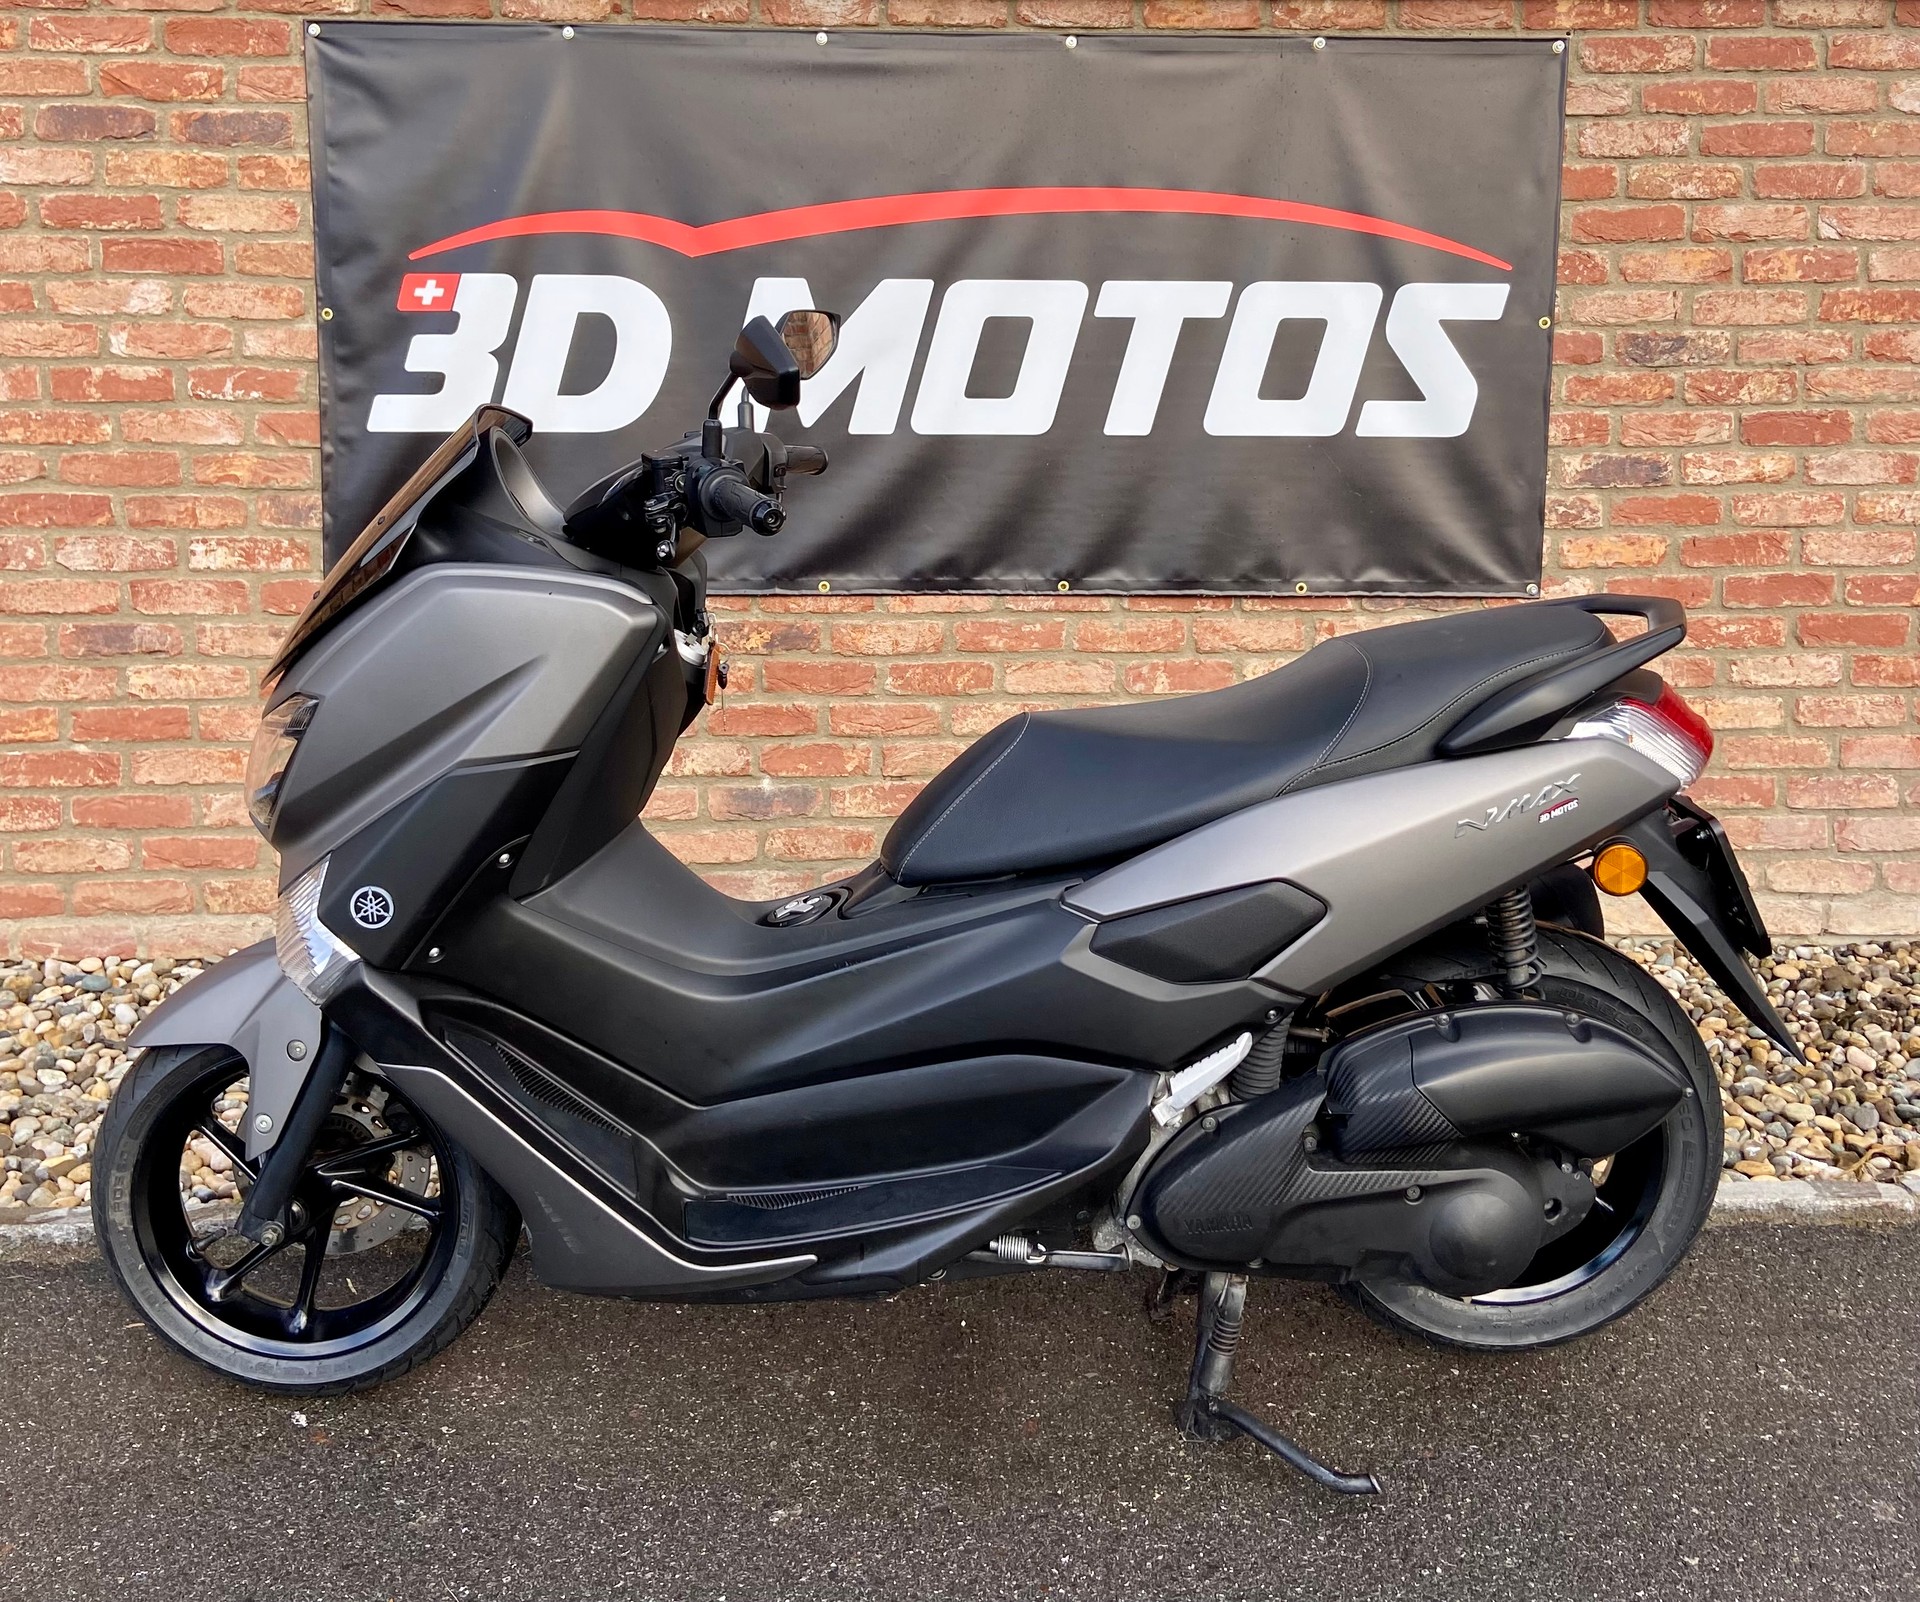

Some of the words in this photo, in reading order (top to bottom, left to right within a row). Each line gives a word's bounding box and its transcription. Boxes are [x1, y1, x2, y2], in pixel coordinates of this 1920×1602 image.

[367, 273, 673, 434] 3D
[716, 277, 1511, 437] MOTOS
[1455, 772, 1582, 839] NMAX
[1539, 812, 1551, 824] 3D
[1550, 800, 1579, 820] MOTOS
[1183, 1213, 1255, 1235] YAMAHA
